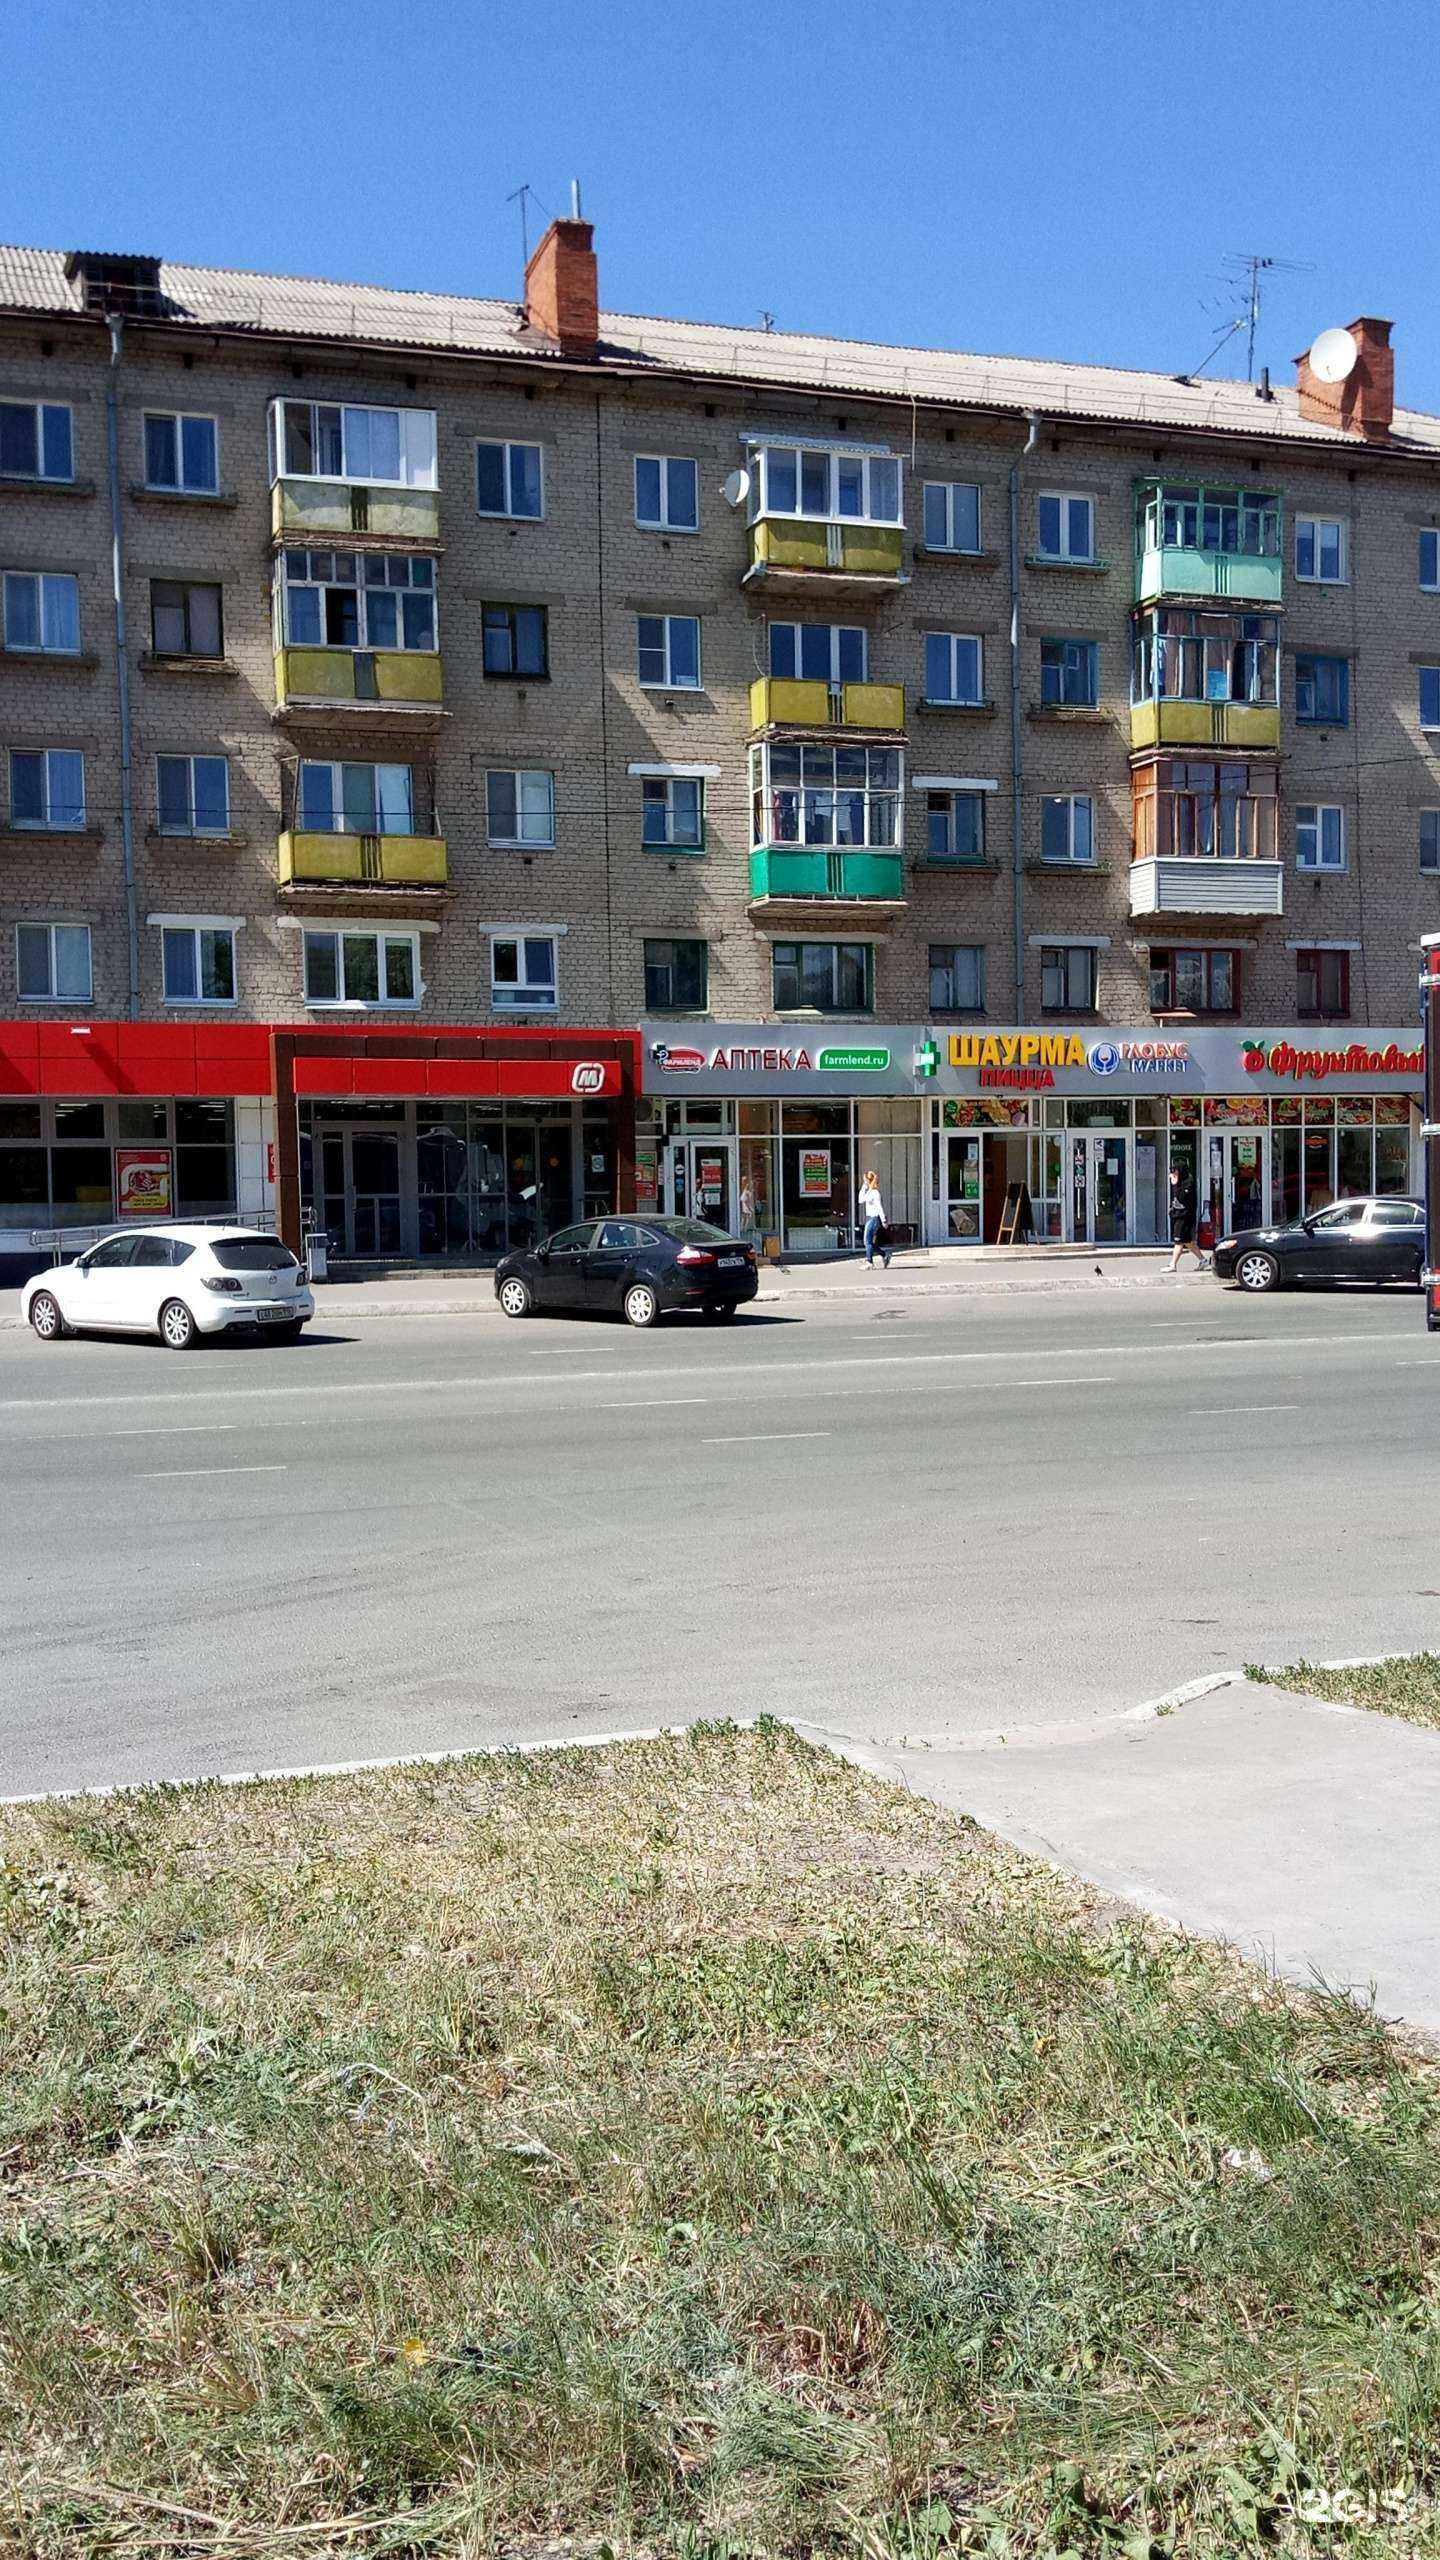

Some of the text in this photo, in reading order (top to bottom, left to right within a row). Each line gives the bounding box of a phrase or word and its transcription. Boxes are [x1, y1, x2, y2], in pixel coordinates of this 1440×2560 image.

[710, 1048, 812, 1071] АПТЕКА
[824, 1050, 884, 1065] farmlend.ru
[949, 1035, 1085, 1066] ШАУРМА
[1119, 1042, 1189, 1059] ГЛОБУС
[1130, 1059, 1188, 1073] МАРКЕТ
[979, 1068, 1056, 1089] ПИЦЦА
